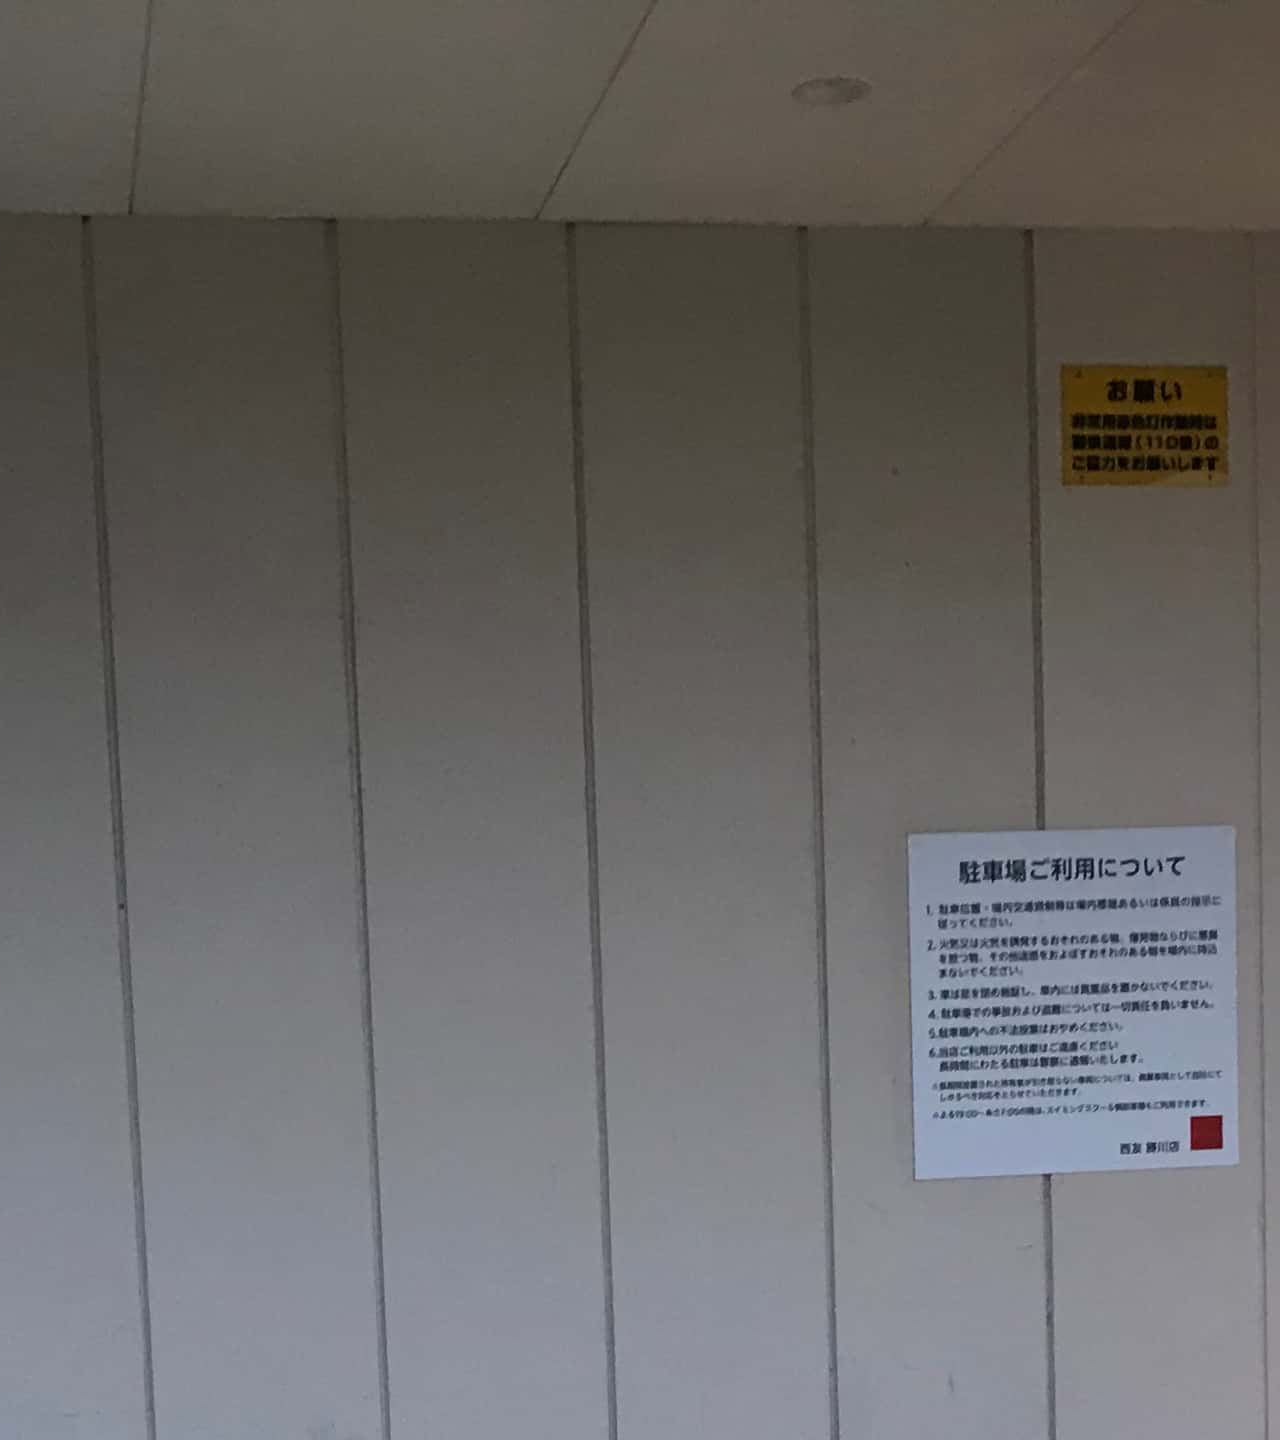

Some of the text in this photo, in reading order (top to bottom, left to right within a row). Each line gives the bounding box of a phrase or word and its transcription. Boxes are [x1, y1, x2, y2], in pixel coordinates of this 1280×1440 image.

[958, 856, 1186, 884] 駐車場ご利用について
